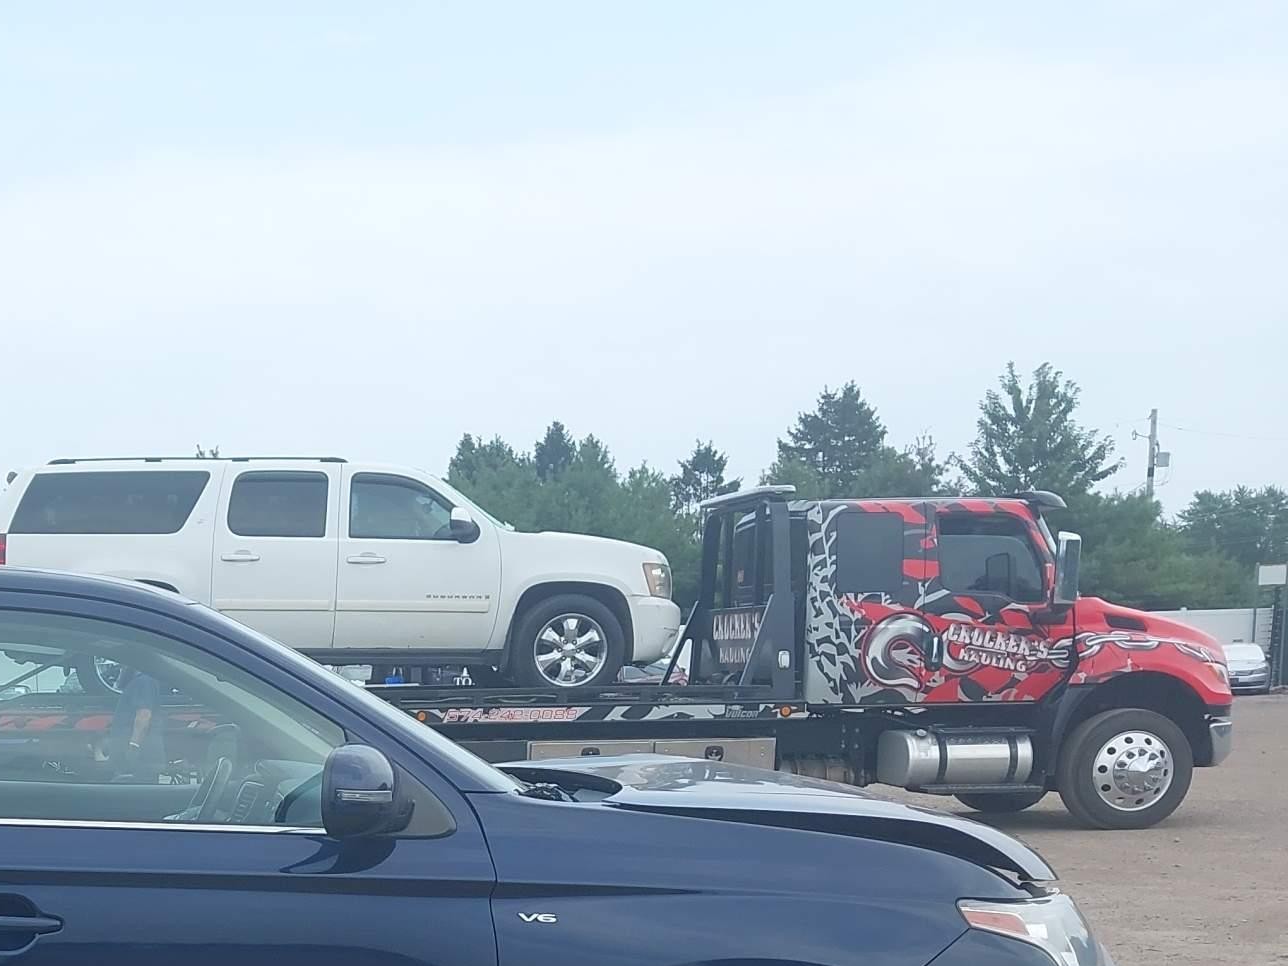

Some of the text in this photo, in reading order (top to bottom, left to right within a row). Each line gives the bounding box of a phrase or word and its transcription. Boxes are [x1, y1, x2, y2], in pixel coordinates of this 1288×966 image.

[947, 623, 1049, 659] CROCKER'S
[958, 648, 1027, 672] HAULING
[517, 912, 557, 924] V6
